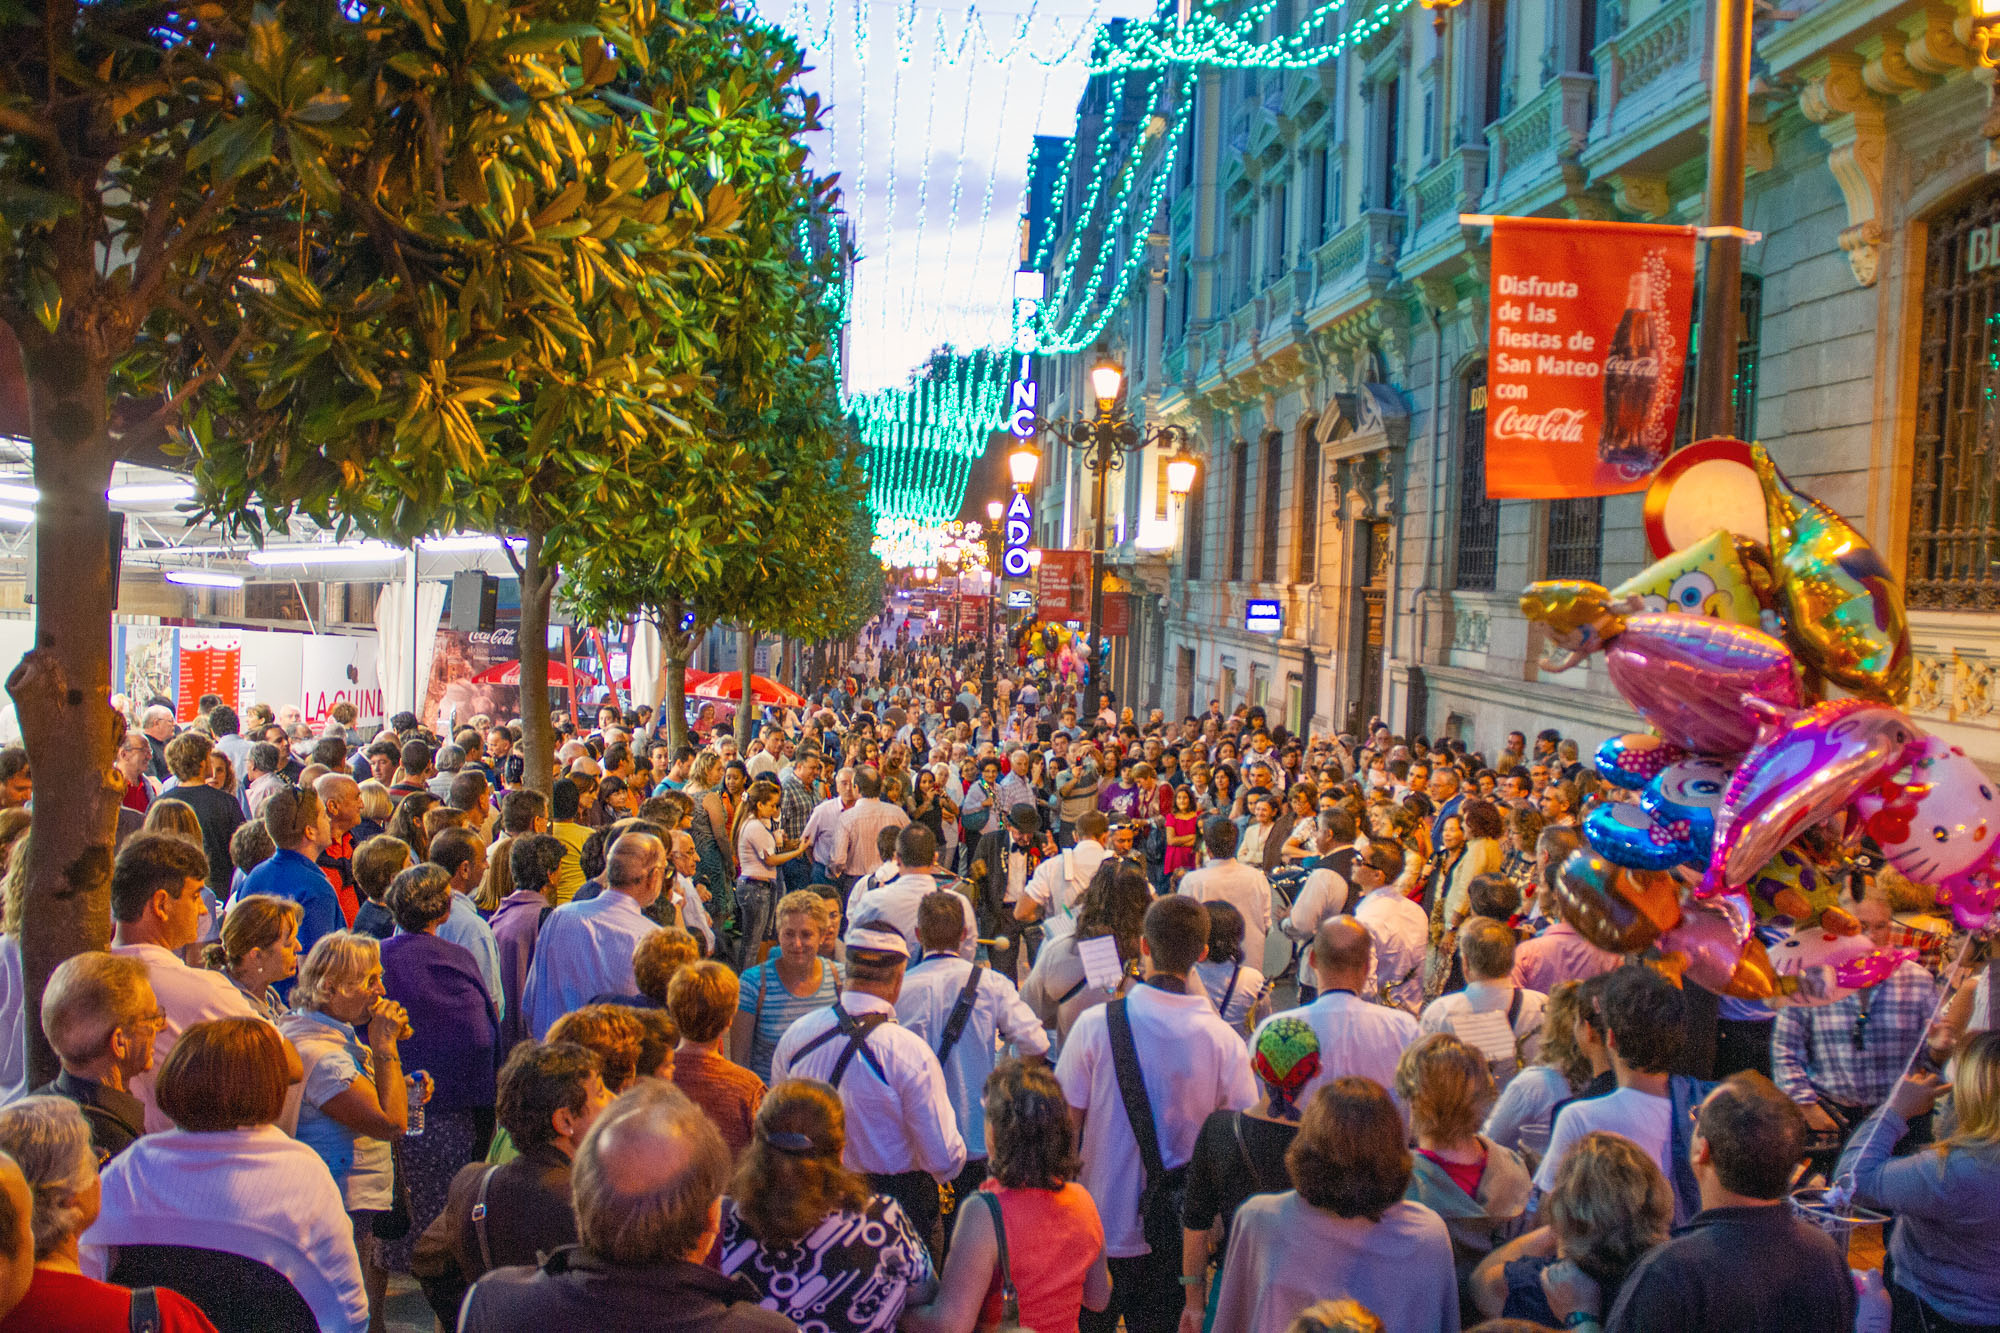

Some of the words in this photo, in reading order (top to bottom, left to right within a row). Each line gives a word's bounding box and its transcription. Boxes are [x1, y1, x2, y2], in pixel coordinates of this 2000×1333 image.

[1498, 275, 1578, 298] Disfruta
[1497, 301, 1522, 322] de
[1528, 303, 1557, 324] las
[1497, 327, 1562, 349] fiestas
[1568, 331, 1595, 351] de
[1496, 353, 1531, 374] San
[1537, 356, 1600, 377] Mateo
[1495, 384, 1528, 399] con
[1493, 405, 1589, 443] Coca-Cola
[1005, 300, 1035, 574] PRINCADO
[305, 690, 328, 722] LA
